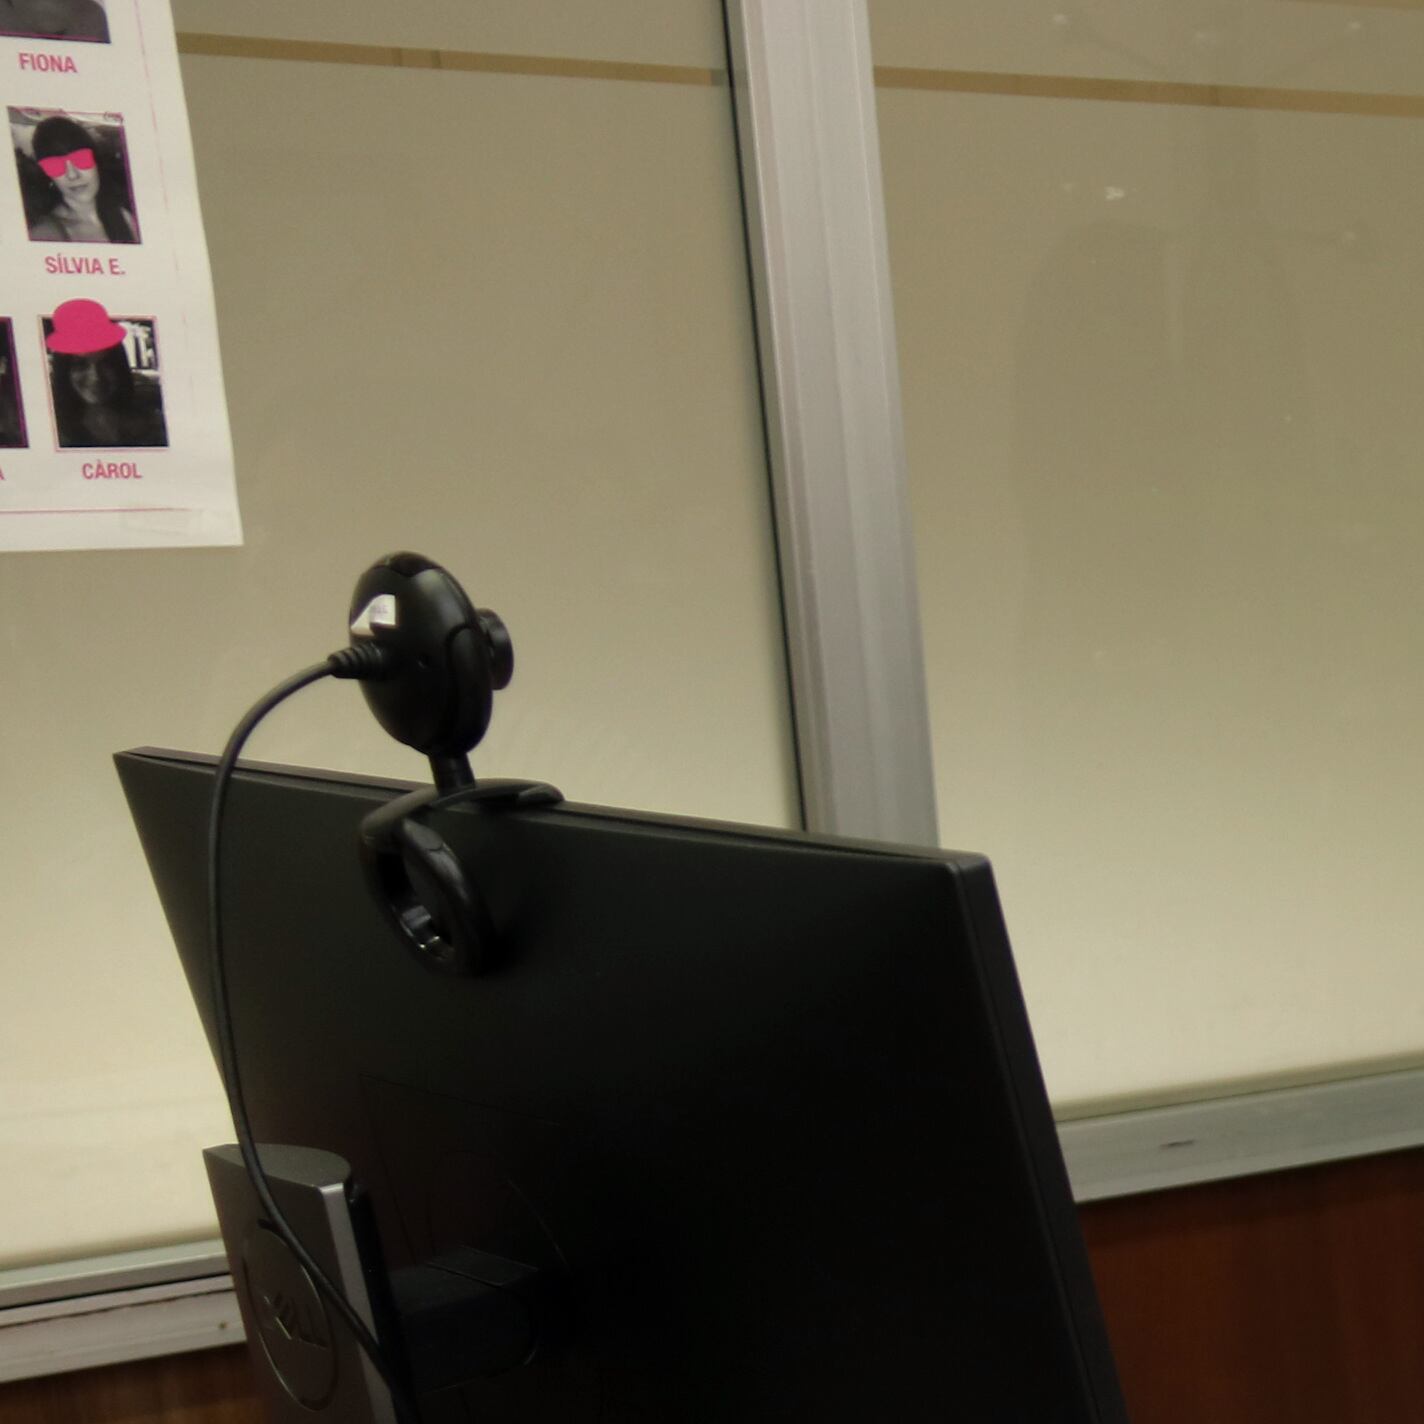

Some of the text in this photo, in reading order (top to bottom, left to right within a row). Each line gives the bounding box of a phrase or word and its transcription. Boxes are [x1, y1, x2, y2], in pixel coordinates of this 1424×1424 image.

[18, 52, 78, 75] FIONA
[44, 254, 127, 276] SÍLVIA E.
[82, 458, 142, 480] CÀROL
